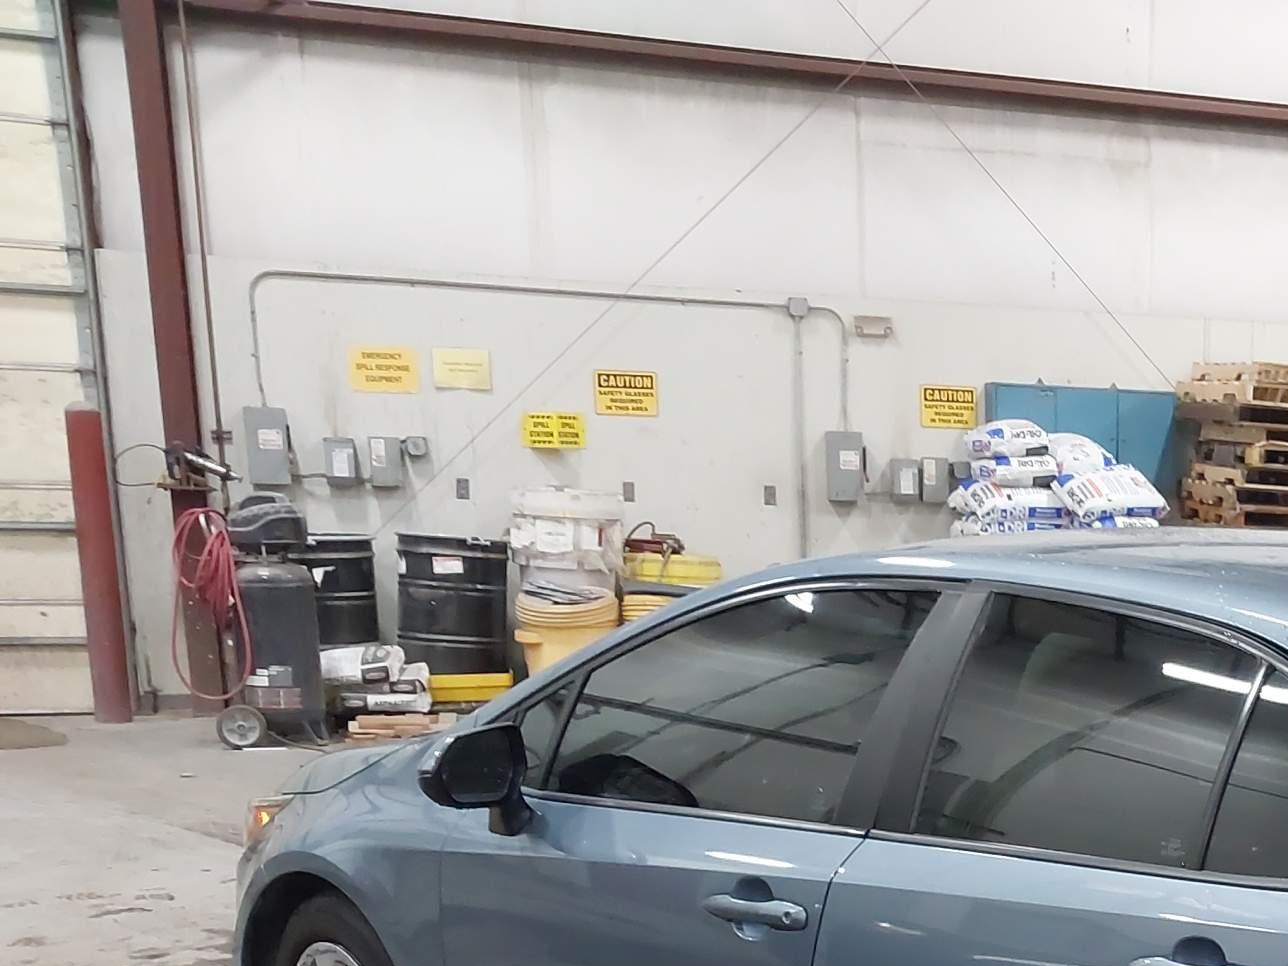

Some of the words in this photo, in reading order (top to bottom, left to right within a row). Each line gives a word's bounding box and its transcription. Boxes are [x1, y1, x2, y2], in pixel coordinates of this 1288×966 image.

[600, 375, 652, 388] CAUTION
[926, 389, 972, 402] CAUTION
[533, 421, 550, 429] SPILL
[561, 422, 576, 430] SPILL
[529, 430, 554, 438] STATION
